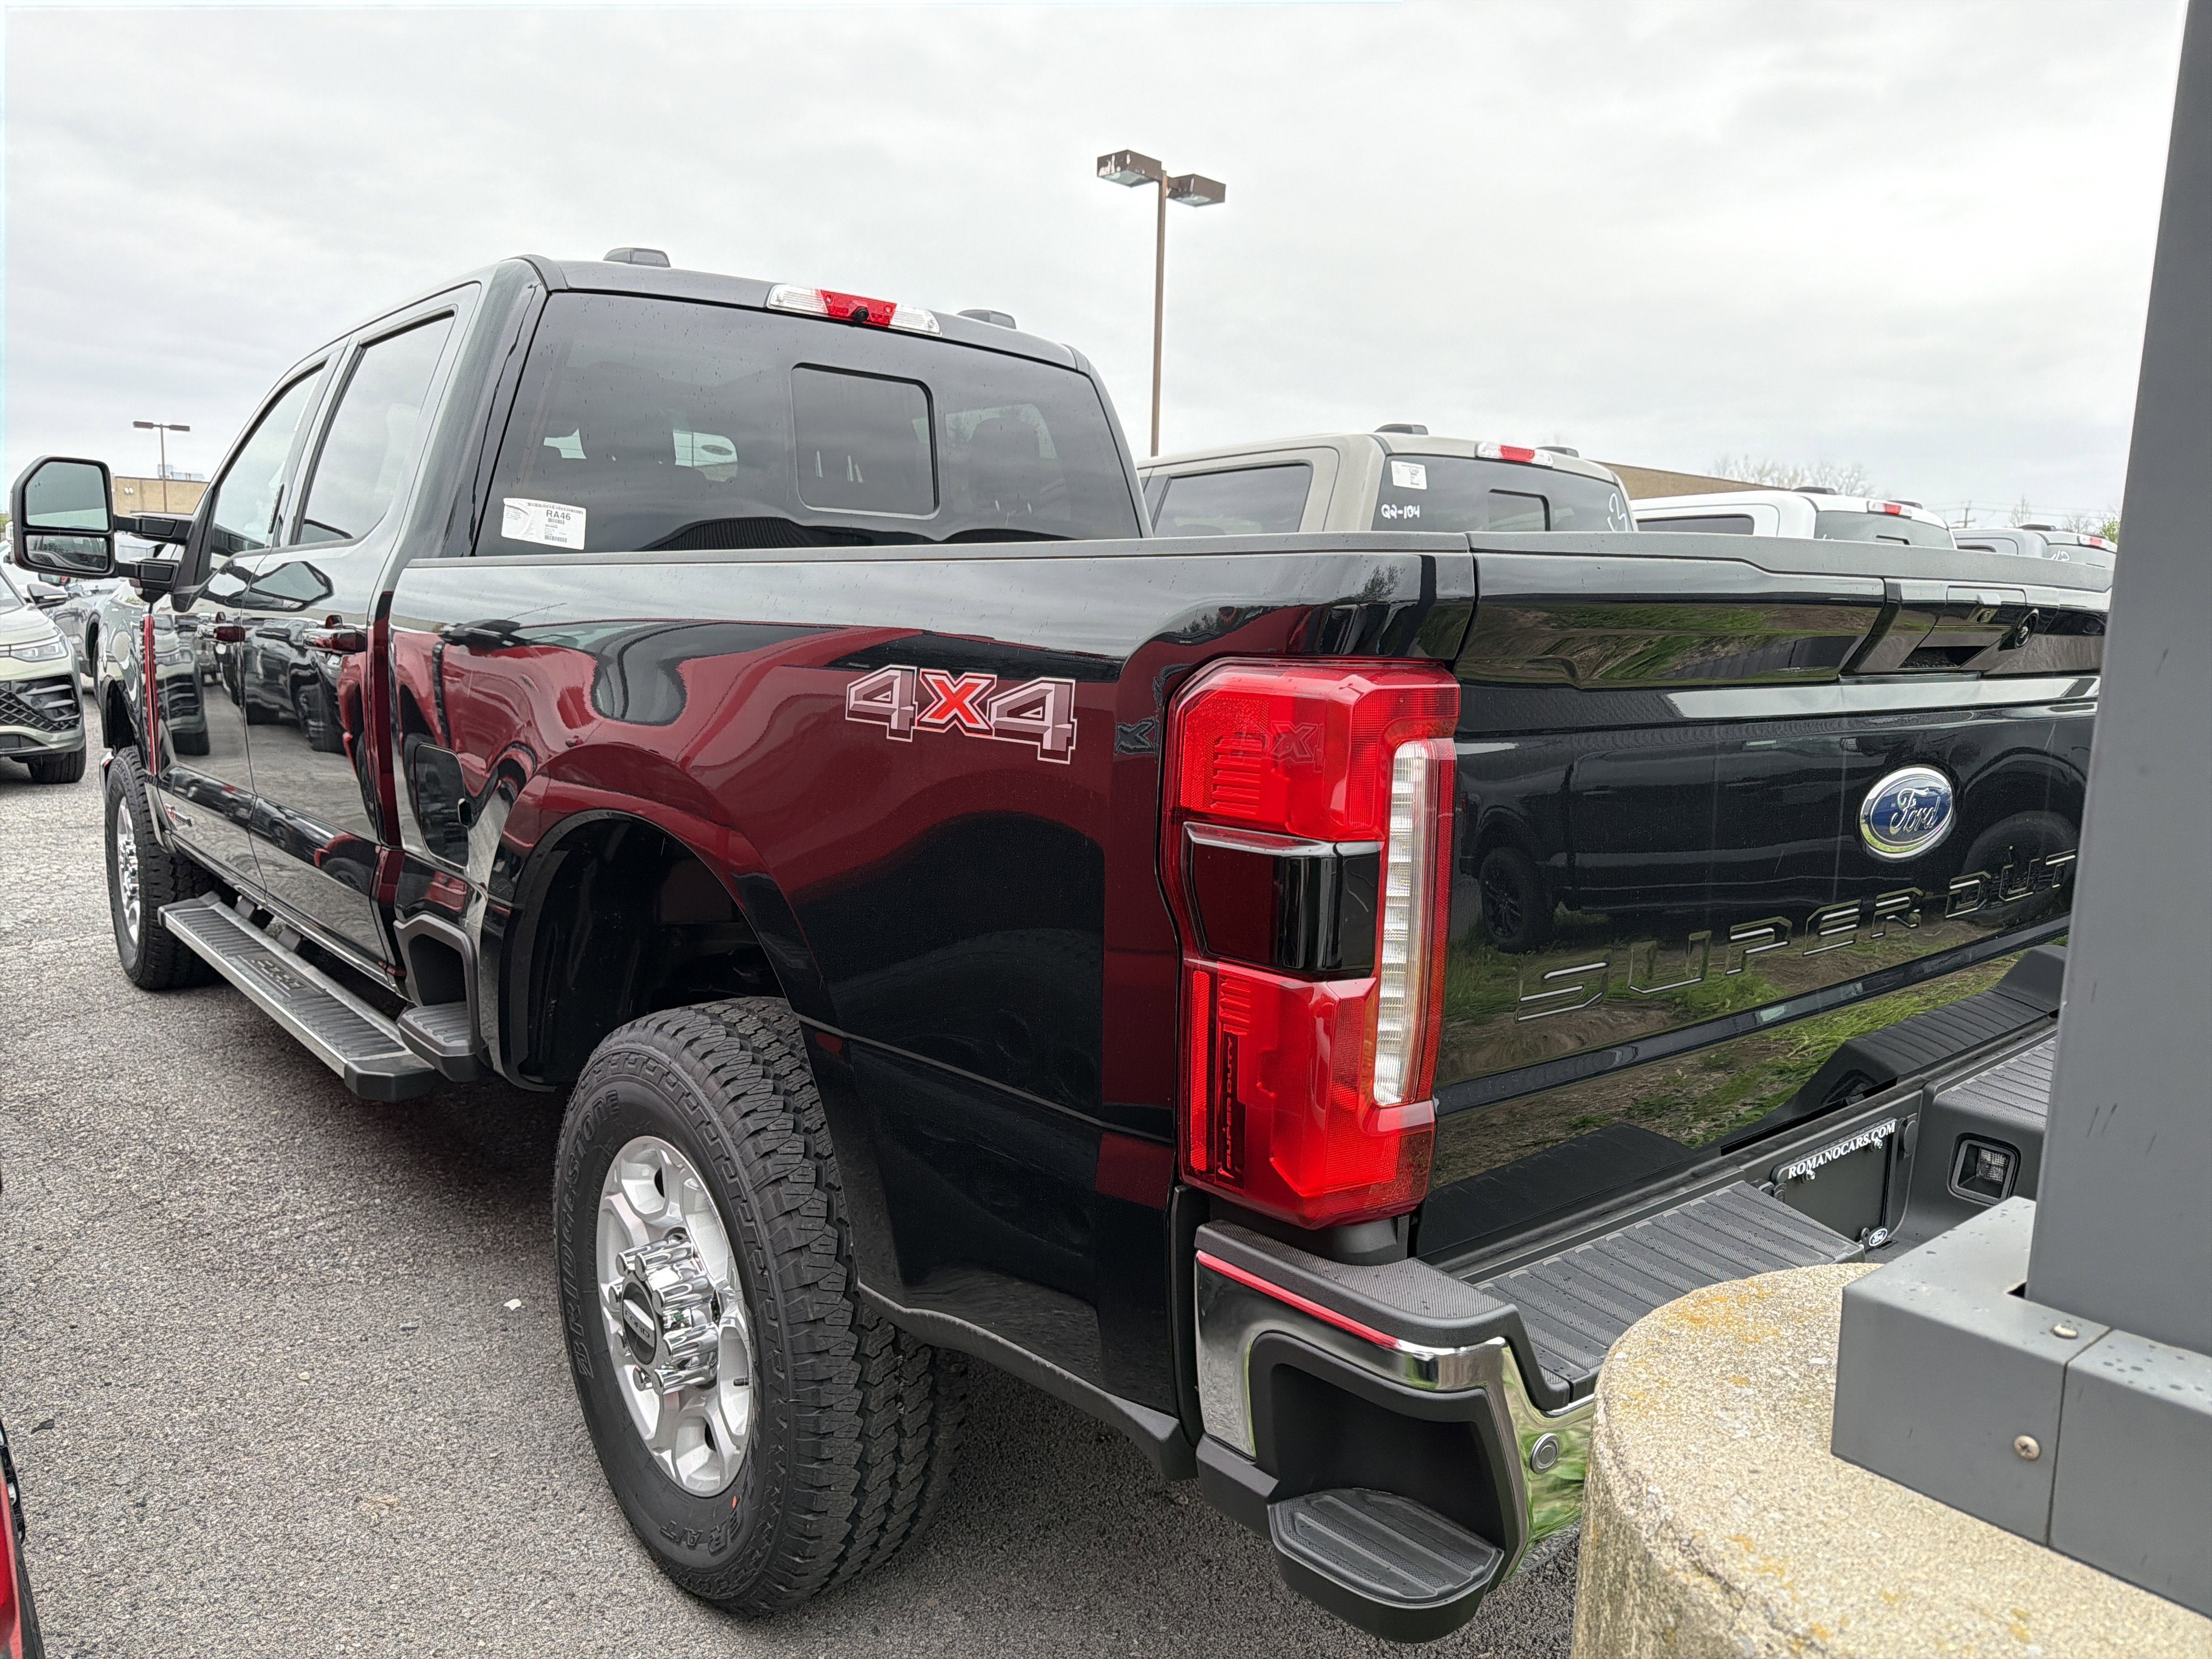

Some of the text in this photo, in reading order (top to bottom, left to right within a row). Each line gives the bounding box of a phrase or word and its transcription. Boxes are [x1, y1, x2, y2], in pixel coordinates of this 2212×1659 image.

[546, 509, 571, 521] RA46
[1381, 504, 1420, 519] Q2-104
[1890, 787, 1940, 834] Ford
[1515, 848, 2078, 1023] SUPER DUT
[1787, 1121, 1895, 1180] ROMANOCARS.COM
[560, 1089, 620, 1380] BRIDGESTONE
